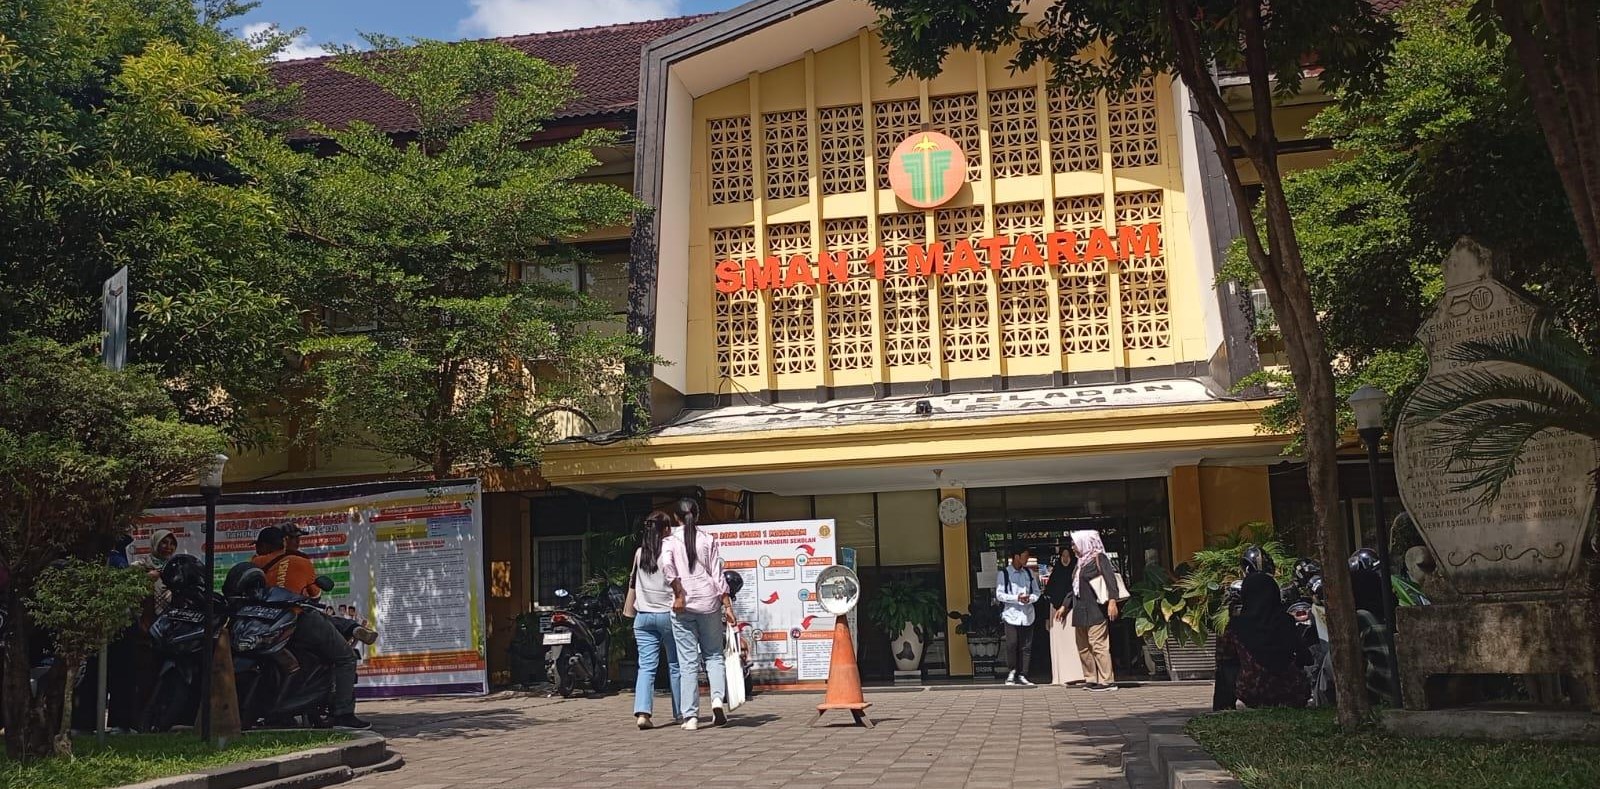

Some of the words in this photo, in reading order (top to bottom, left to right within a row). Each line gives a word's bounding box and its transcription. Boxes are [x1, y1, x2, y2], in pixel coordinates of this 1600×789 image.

[715, 250, 848, 293] SMAN
[866, 246, 885, 280] 1
[907, 222, 1160, 277] MATARAM
[944, 384, 1174, 405] TELADAN
